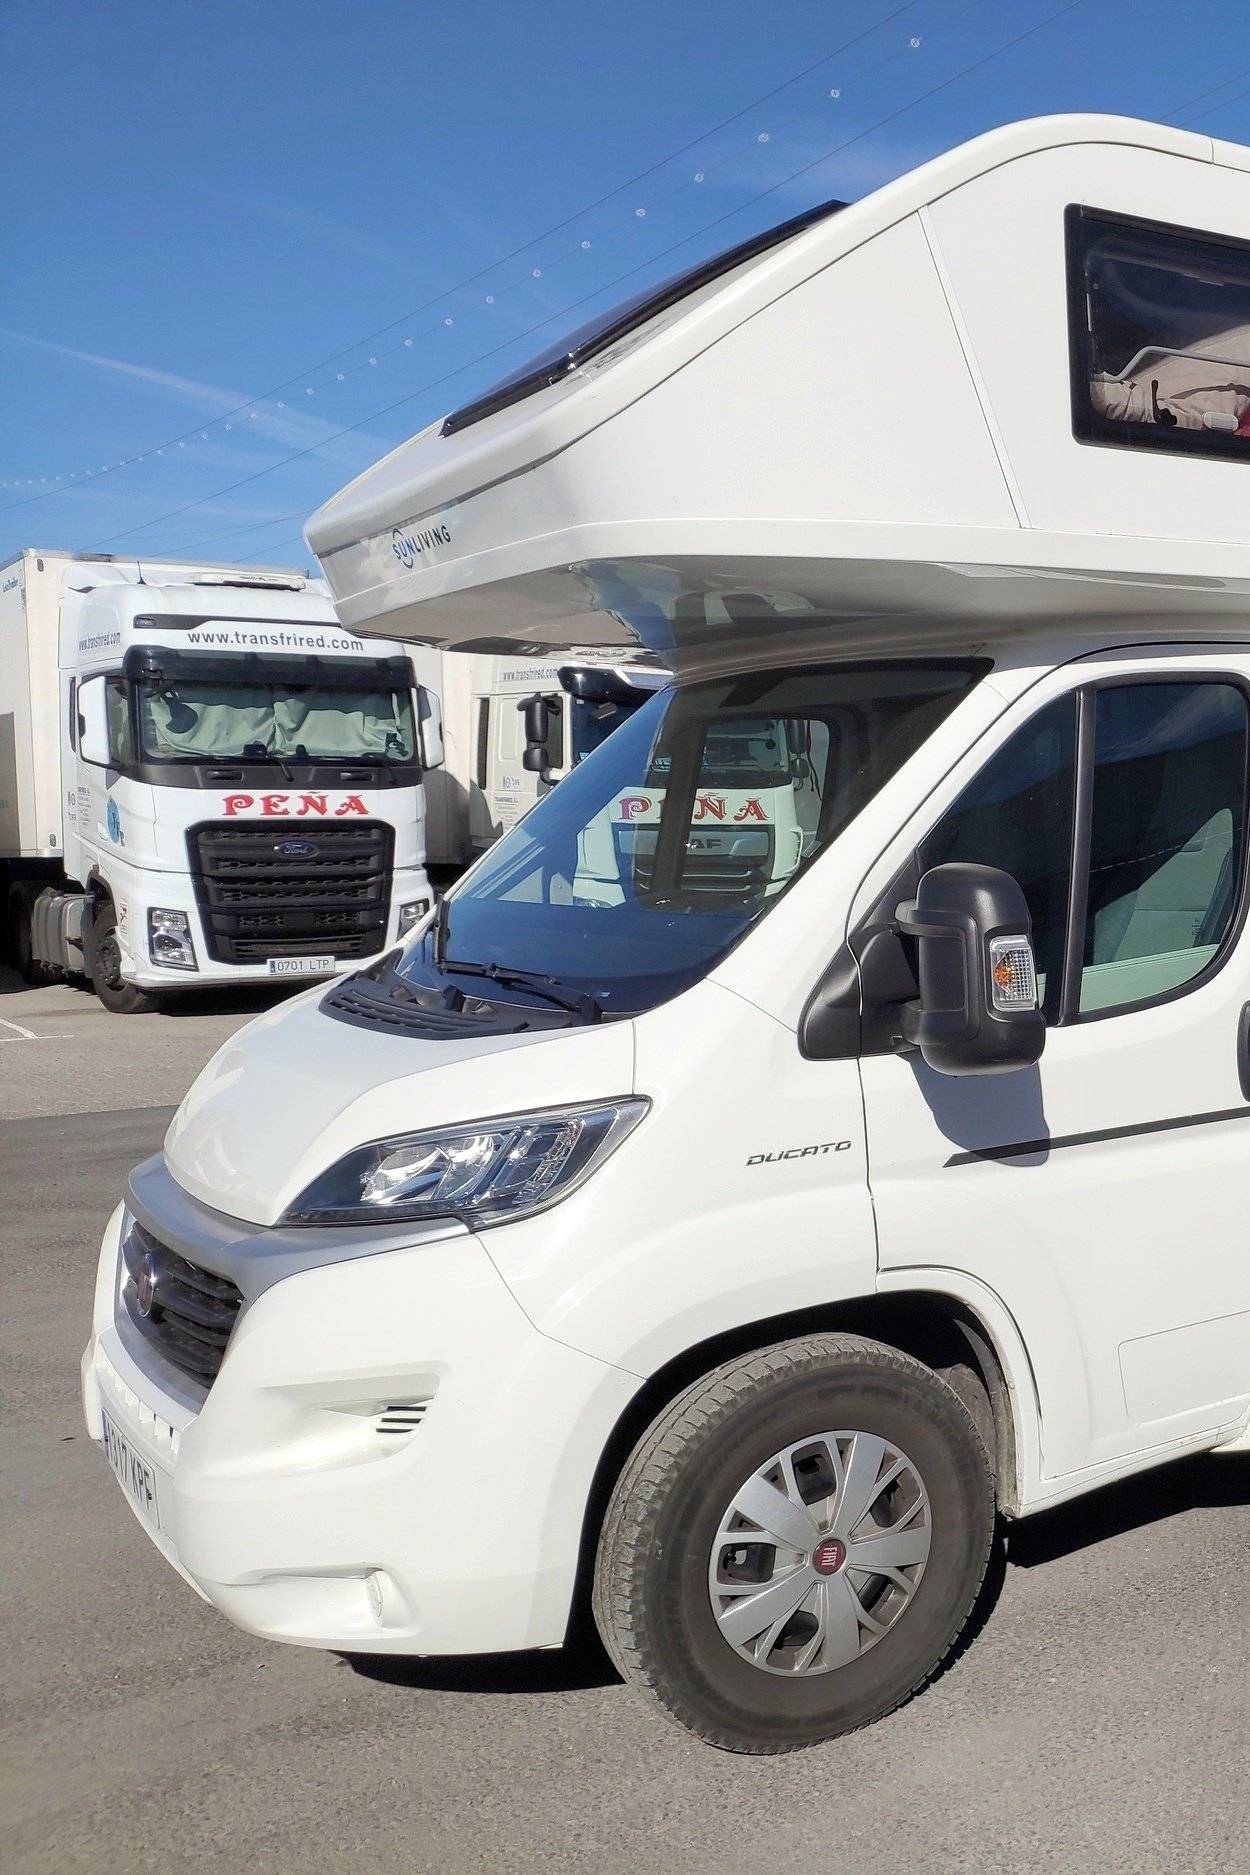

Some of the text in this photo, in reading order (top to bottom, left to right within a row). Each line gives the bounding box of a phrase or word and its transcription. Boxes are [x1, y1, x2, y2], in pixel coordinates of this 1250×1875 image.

[392, 525, 451, 560] SUNLIVING
[187, 631, 364, 651] www.transfrired.com
[222, 791, 370, 816] PEÑA
[618, 792, 771, 822] PÑA
[283, 843, 309, 854] Ford
[277, 959, 330, 972] 0701 LTP
[746, 1140, 852, 1166] DUCATO
[821, 1546, 838, 1568] FIAT
